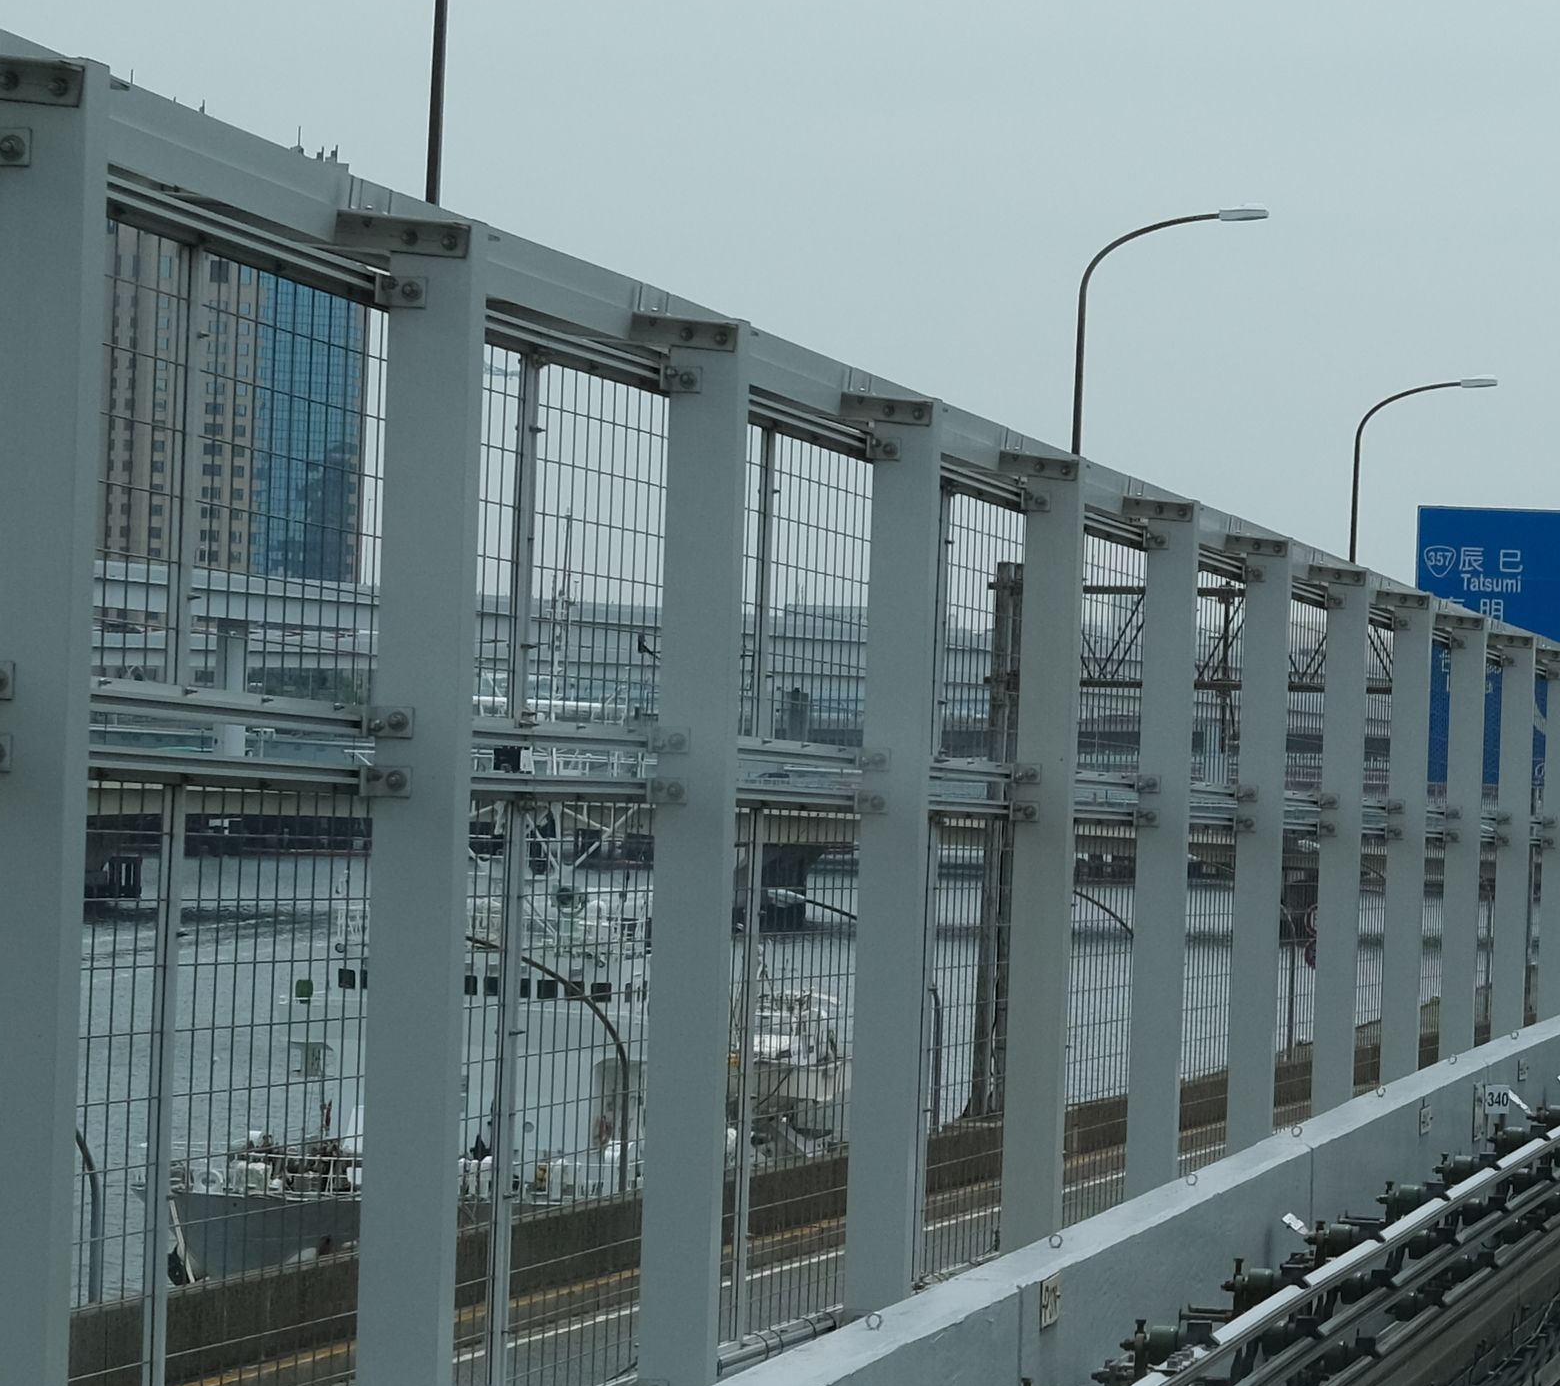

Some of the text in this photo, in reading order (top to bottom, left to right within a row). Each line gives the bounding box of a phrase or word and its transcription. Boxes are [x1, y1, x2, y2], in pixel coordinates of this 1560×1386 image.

[1427, 551, 1452, 566] 357
[1459, 547, 1523, 573] 辰巳
[1460, 573, 1521, 593] Tatsumi
[1487, 1092, 1509, 1107] 340
